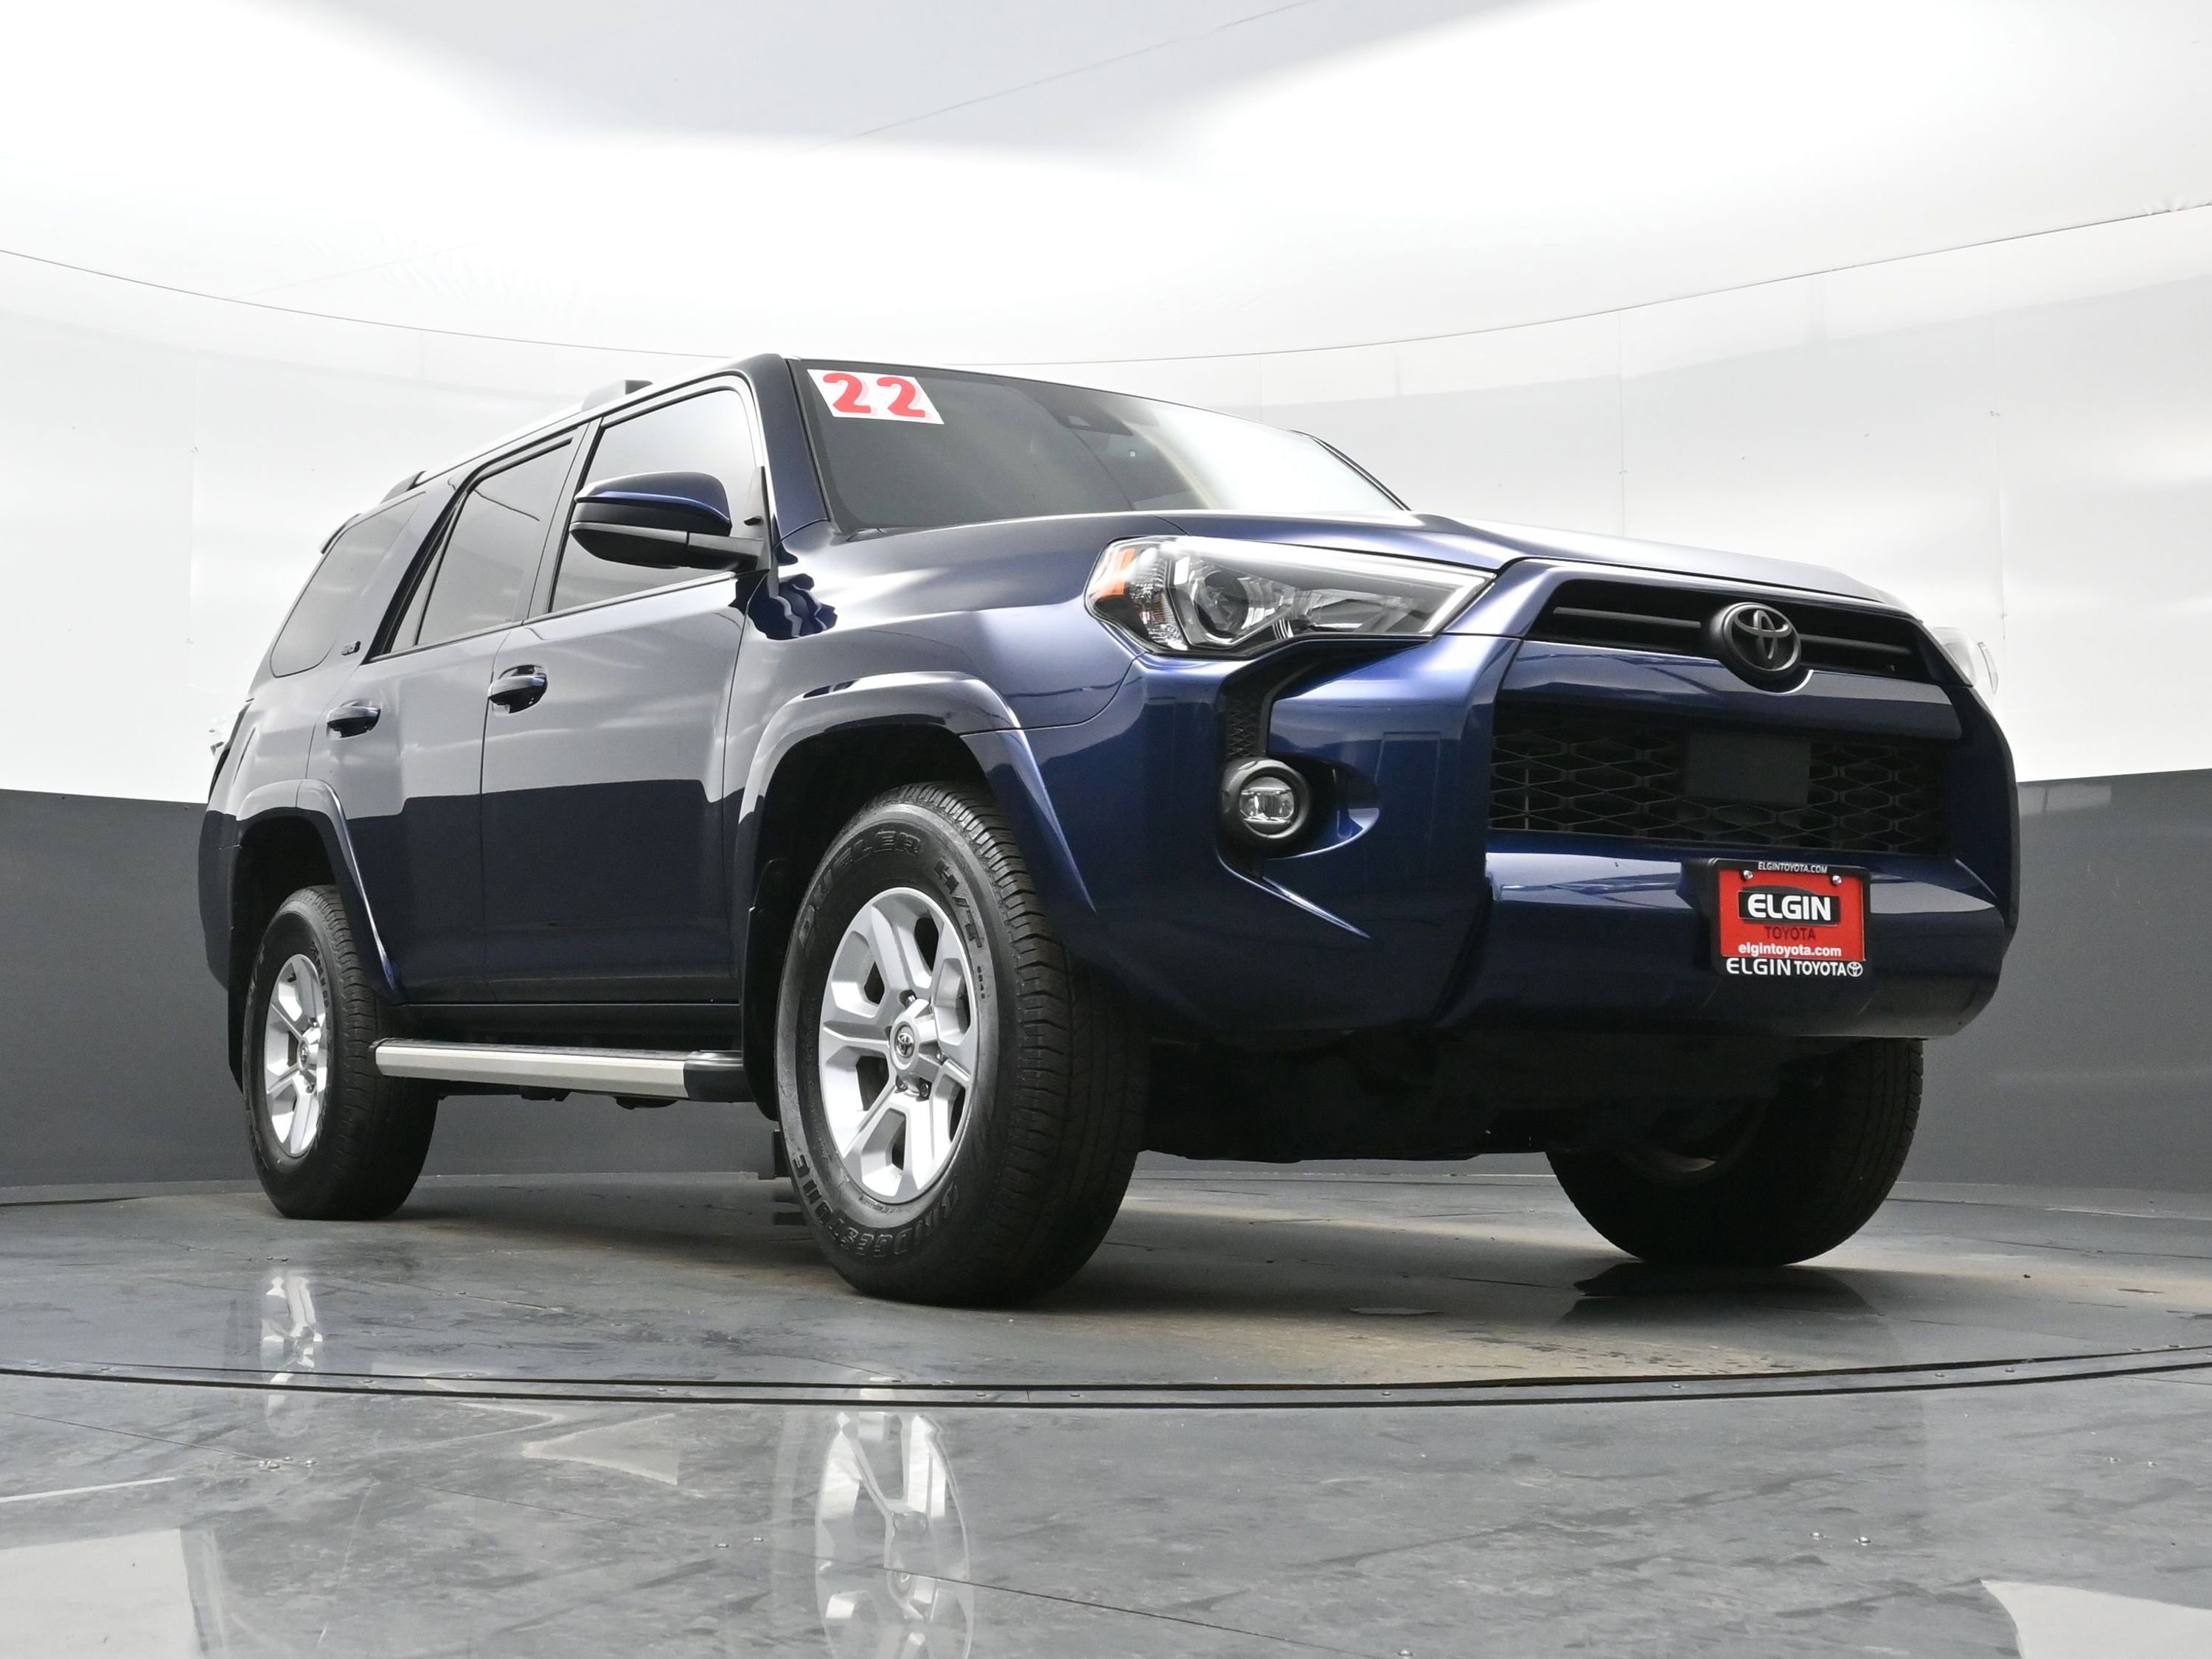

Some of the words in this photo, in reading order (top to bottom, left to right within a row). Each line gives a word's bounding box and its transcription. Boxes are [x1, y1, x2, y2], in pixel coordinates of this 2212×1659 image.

[822, 372, 926, 418] 22
[1758, 861, 1828, 874] ELGINTOYOTA.COM
[1747, 894, 1832, 921] ELGIN
[1764, 926, 1816, 940] TOYOTA
[1738, 942, 1842, 958] elgintoyota.com
[1726, 958, 1792, 975] ELGIN
[1794, 961, 1848, 976] TOYOTA
